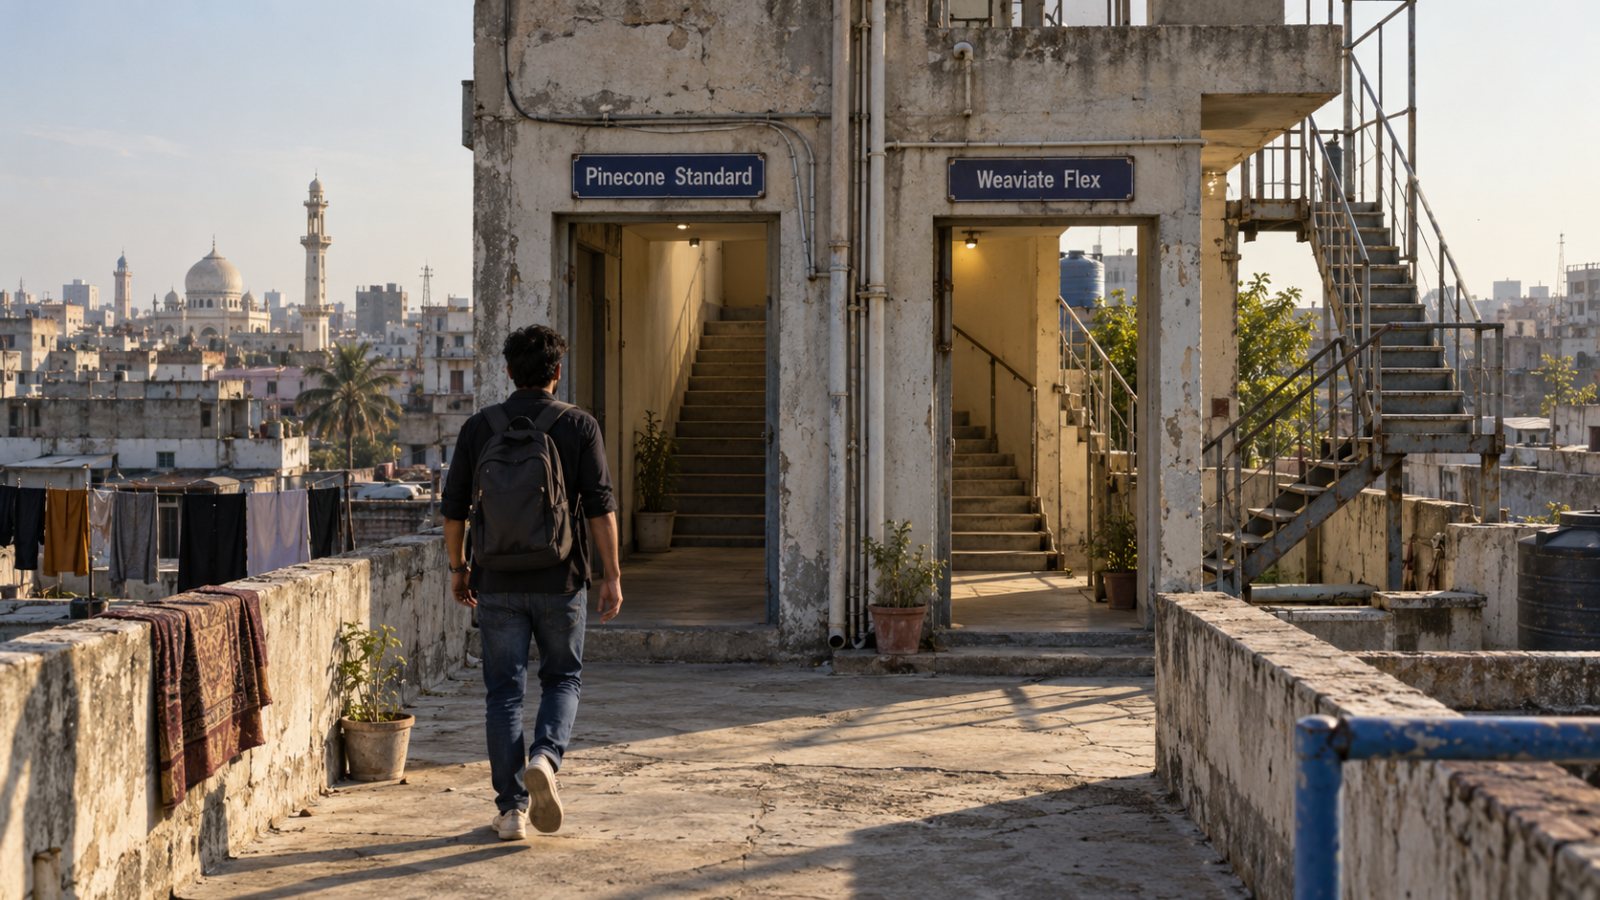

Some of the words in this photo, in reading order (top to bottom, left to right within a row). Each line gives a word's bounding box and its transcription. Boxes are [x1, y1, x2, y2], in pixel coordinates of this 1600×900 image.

[586, 166, 665, 186] Pinecone
[675, 166, 752, 186] Standard
[977, 169, 1054, 189] Weaviate
[1064, 169, 1101, 189] Flex
